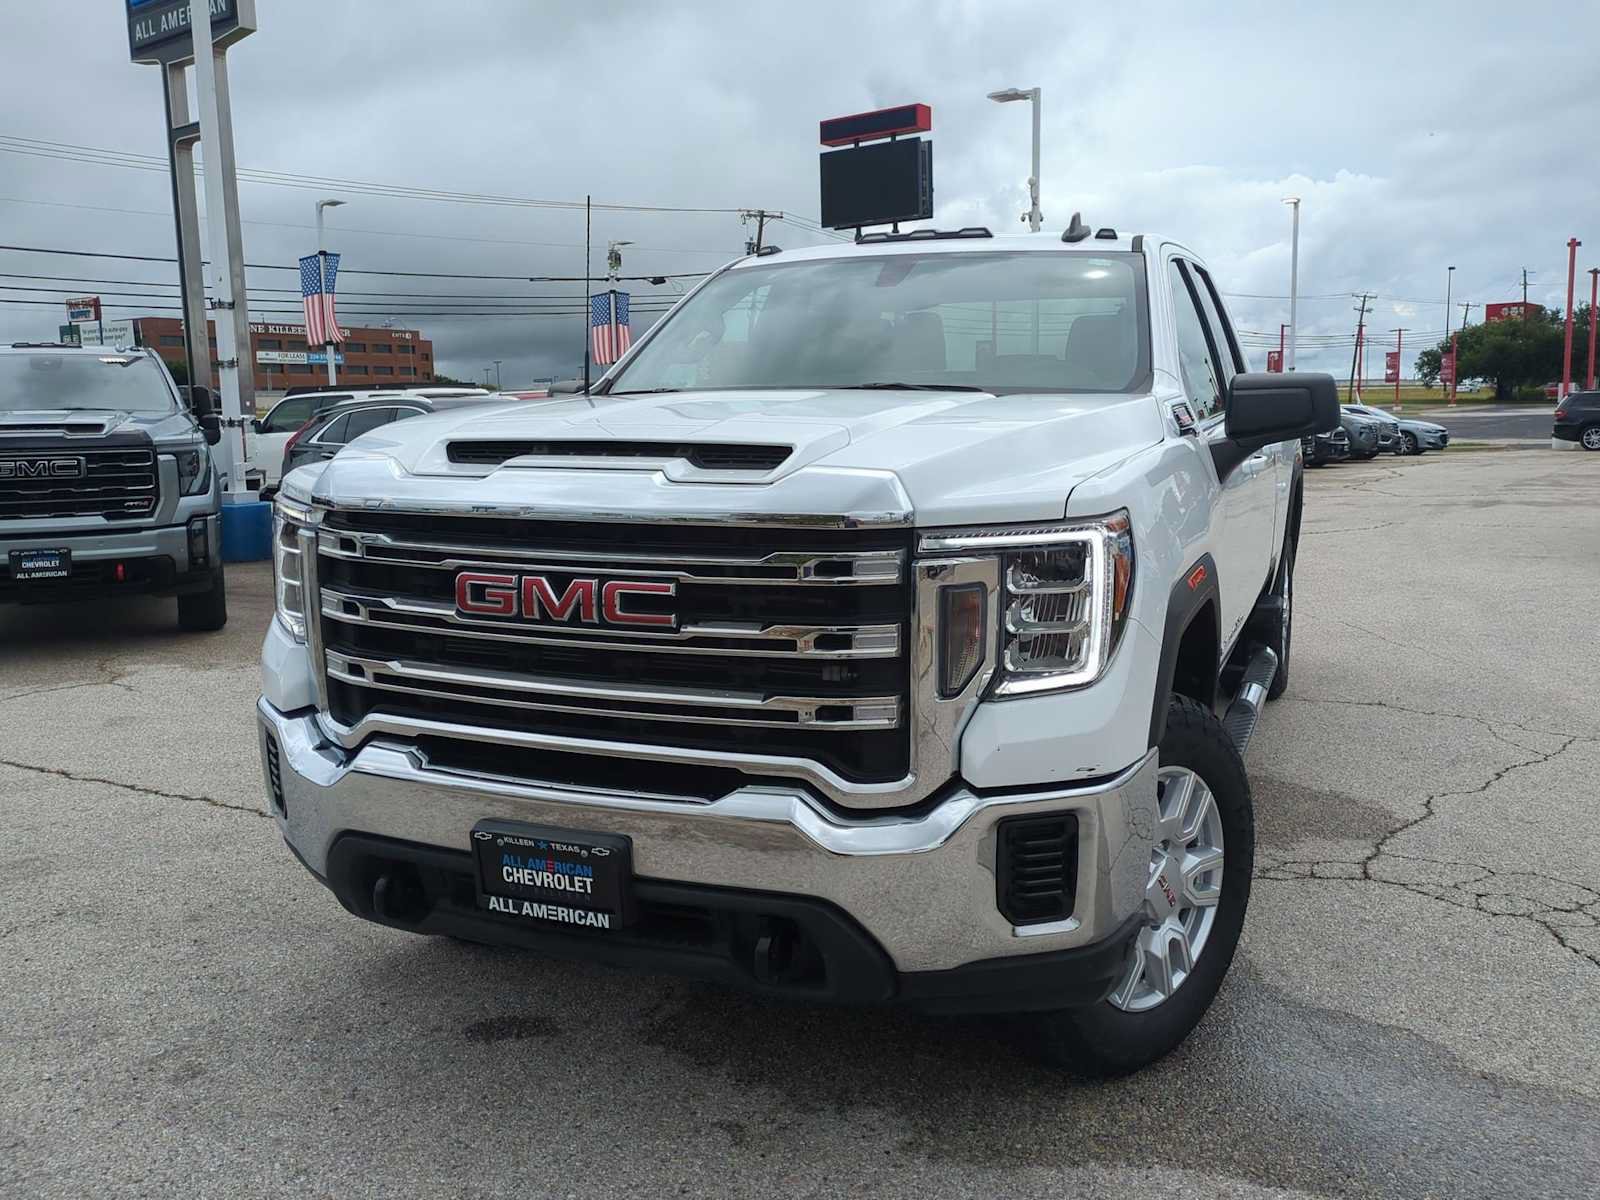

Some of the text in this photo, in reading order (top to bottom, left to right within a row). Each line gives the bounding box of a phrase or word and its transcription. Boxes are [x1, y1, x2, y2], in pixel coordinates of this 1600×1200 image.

[135, 19, 157, 41] ALL
[268, 325, 307, 335] KILLEE
[22, 560, 60, 568] CHEVROLET
[455, 571, 677, 628] GMC
[503, 836, 581, 853] KILLEEN TEXAS
[502, 854, 593, 877] ALL AMERICAN
[502, 865, 593, 894] CHEVROLET
[488, 896, 610, 928] ALL AMERICAN
